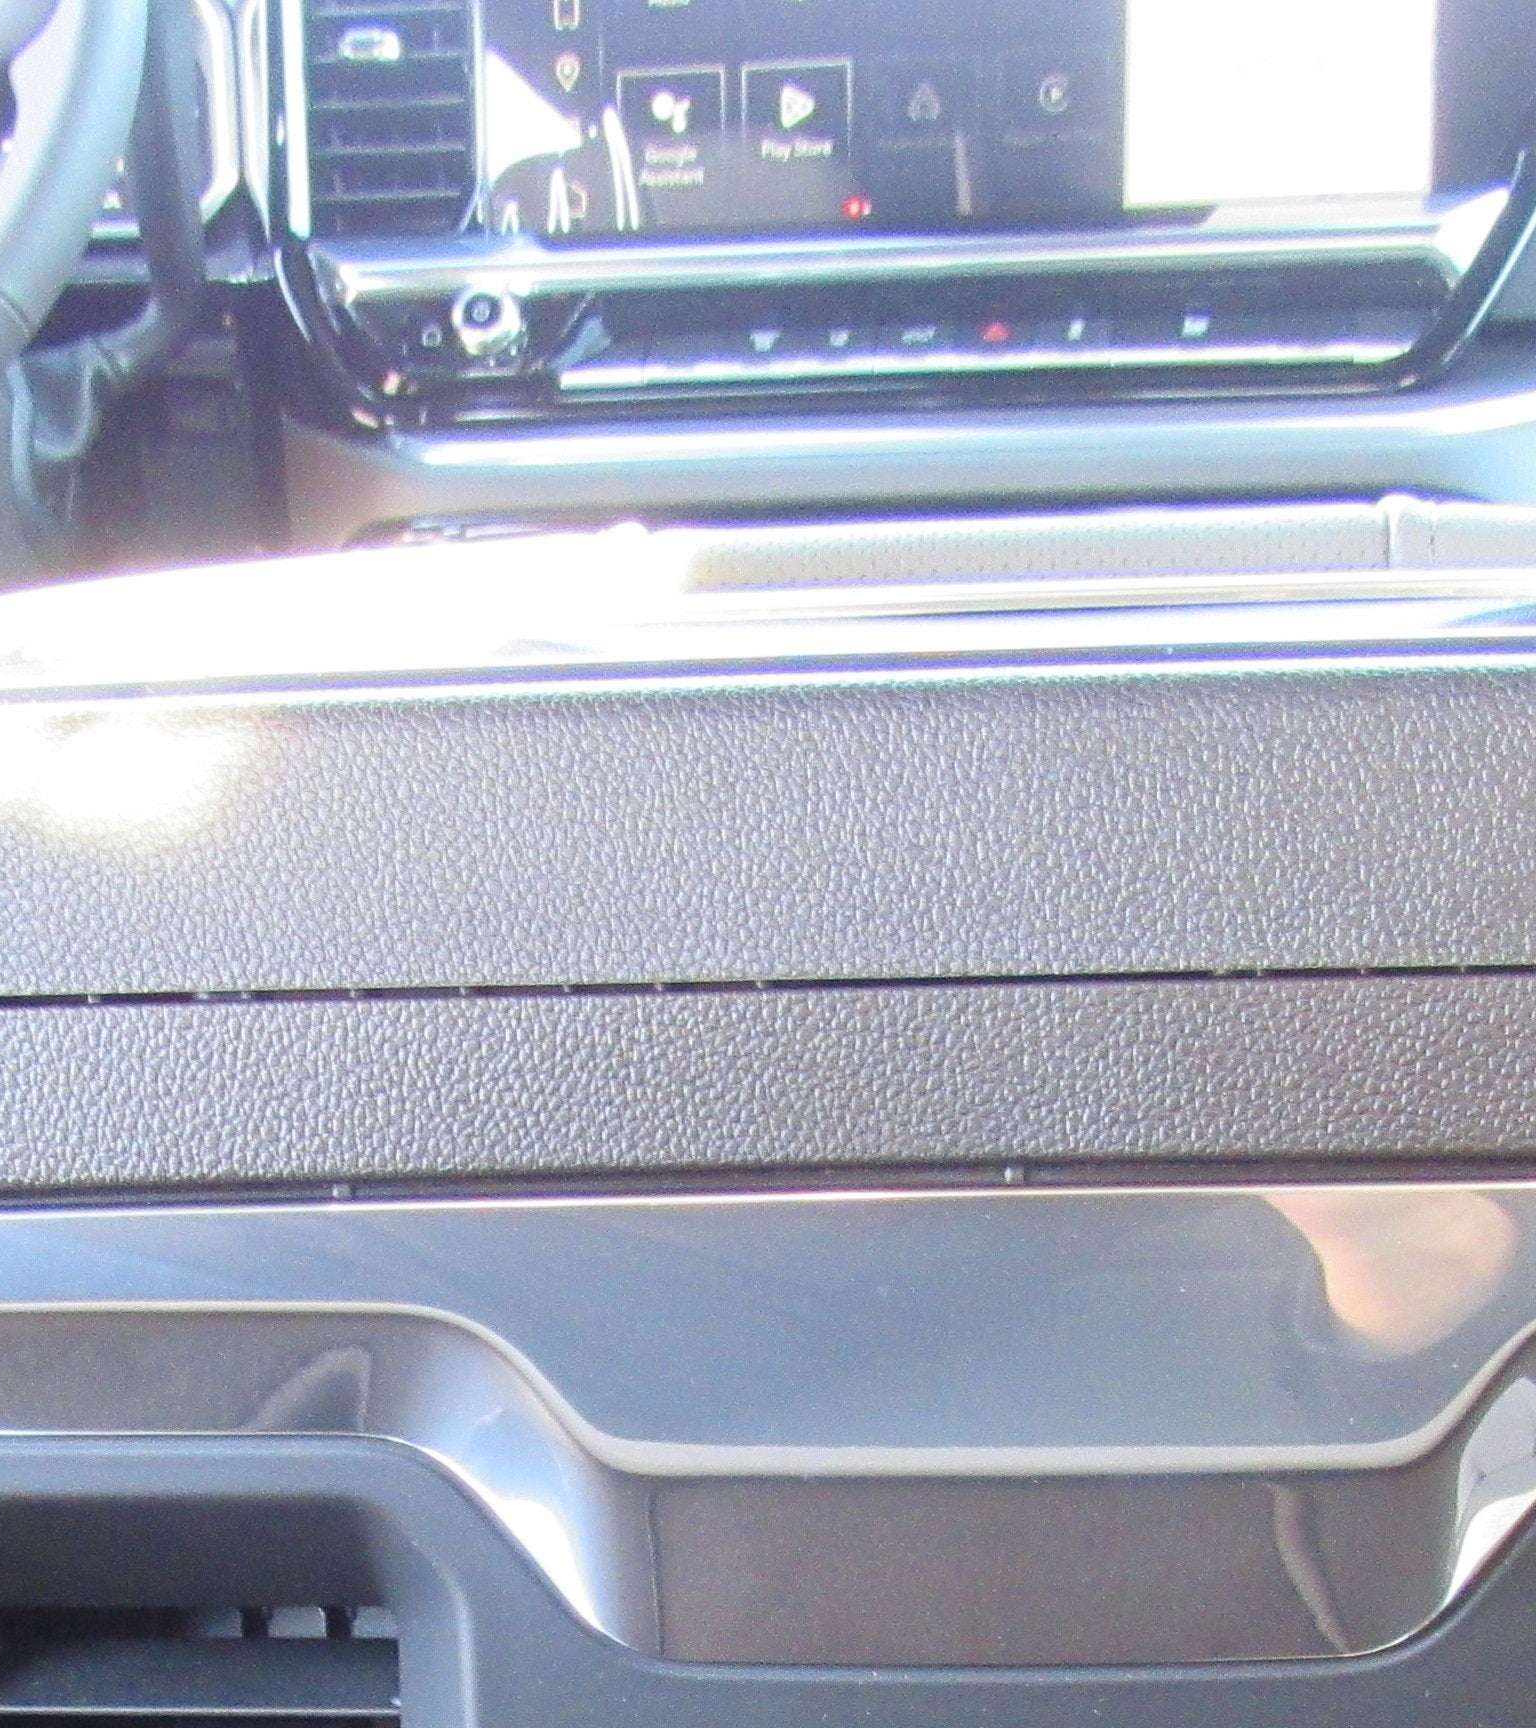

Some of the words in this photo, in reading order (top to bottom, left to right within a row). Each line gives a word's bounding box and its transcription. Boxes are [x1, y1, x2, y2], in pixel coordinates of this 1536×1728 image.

[644, 145, 698, 166] Google
[761, 139, 791, 162] Play
[793, 139, 833, 158] Store
[640, 167, 705, 187] Assistant
